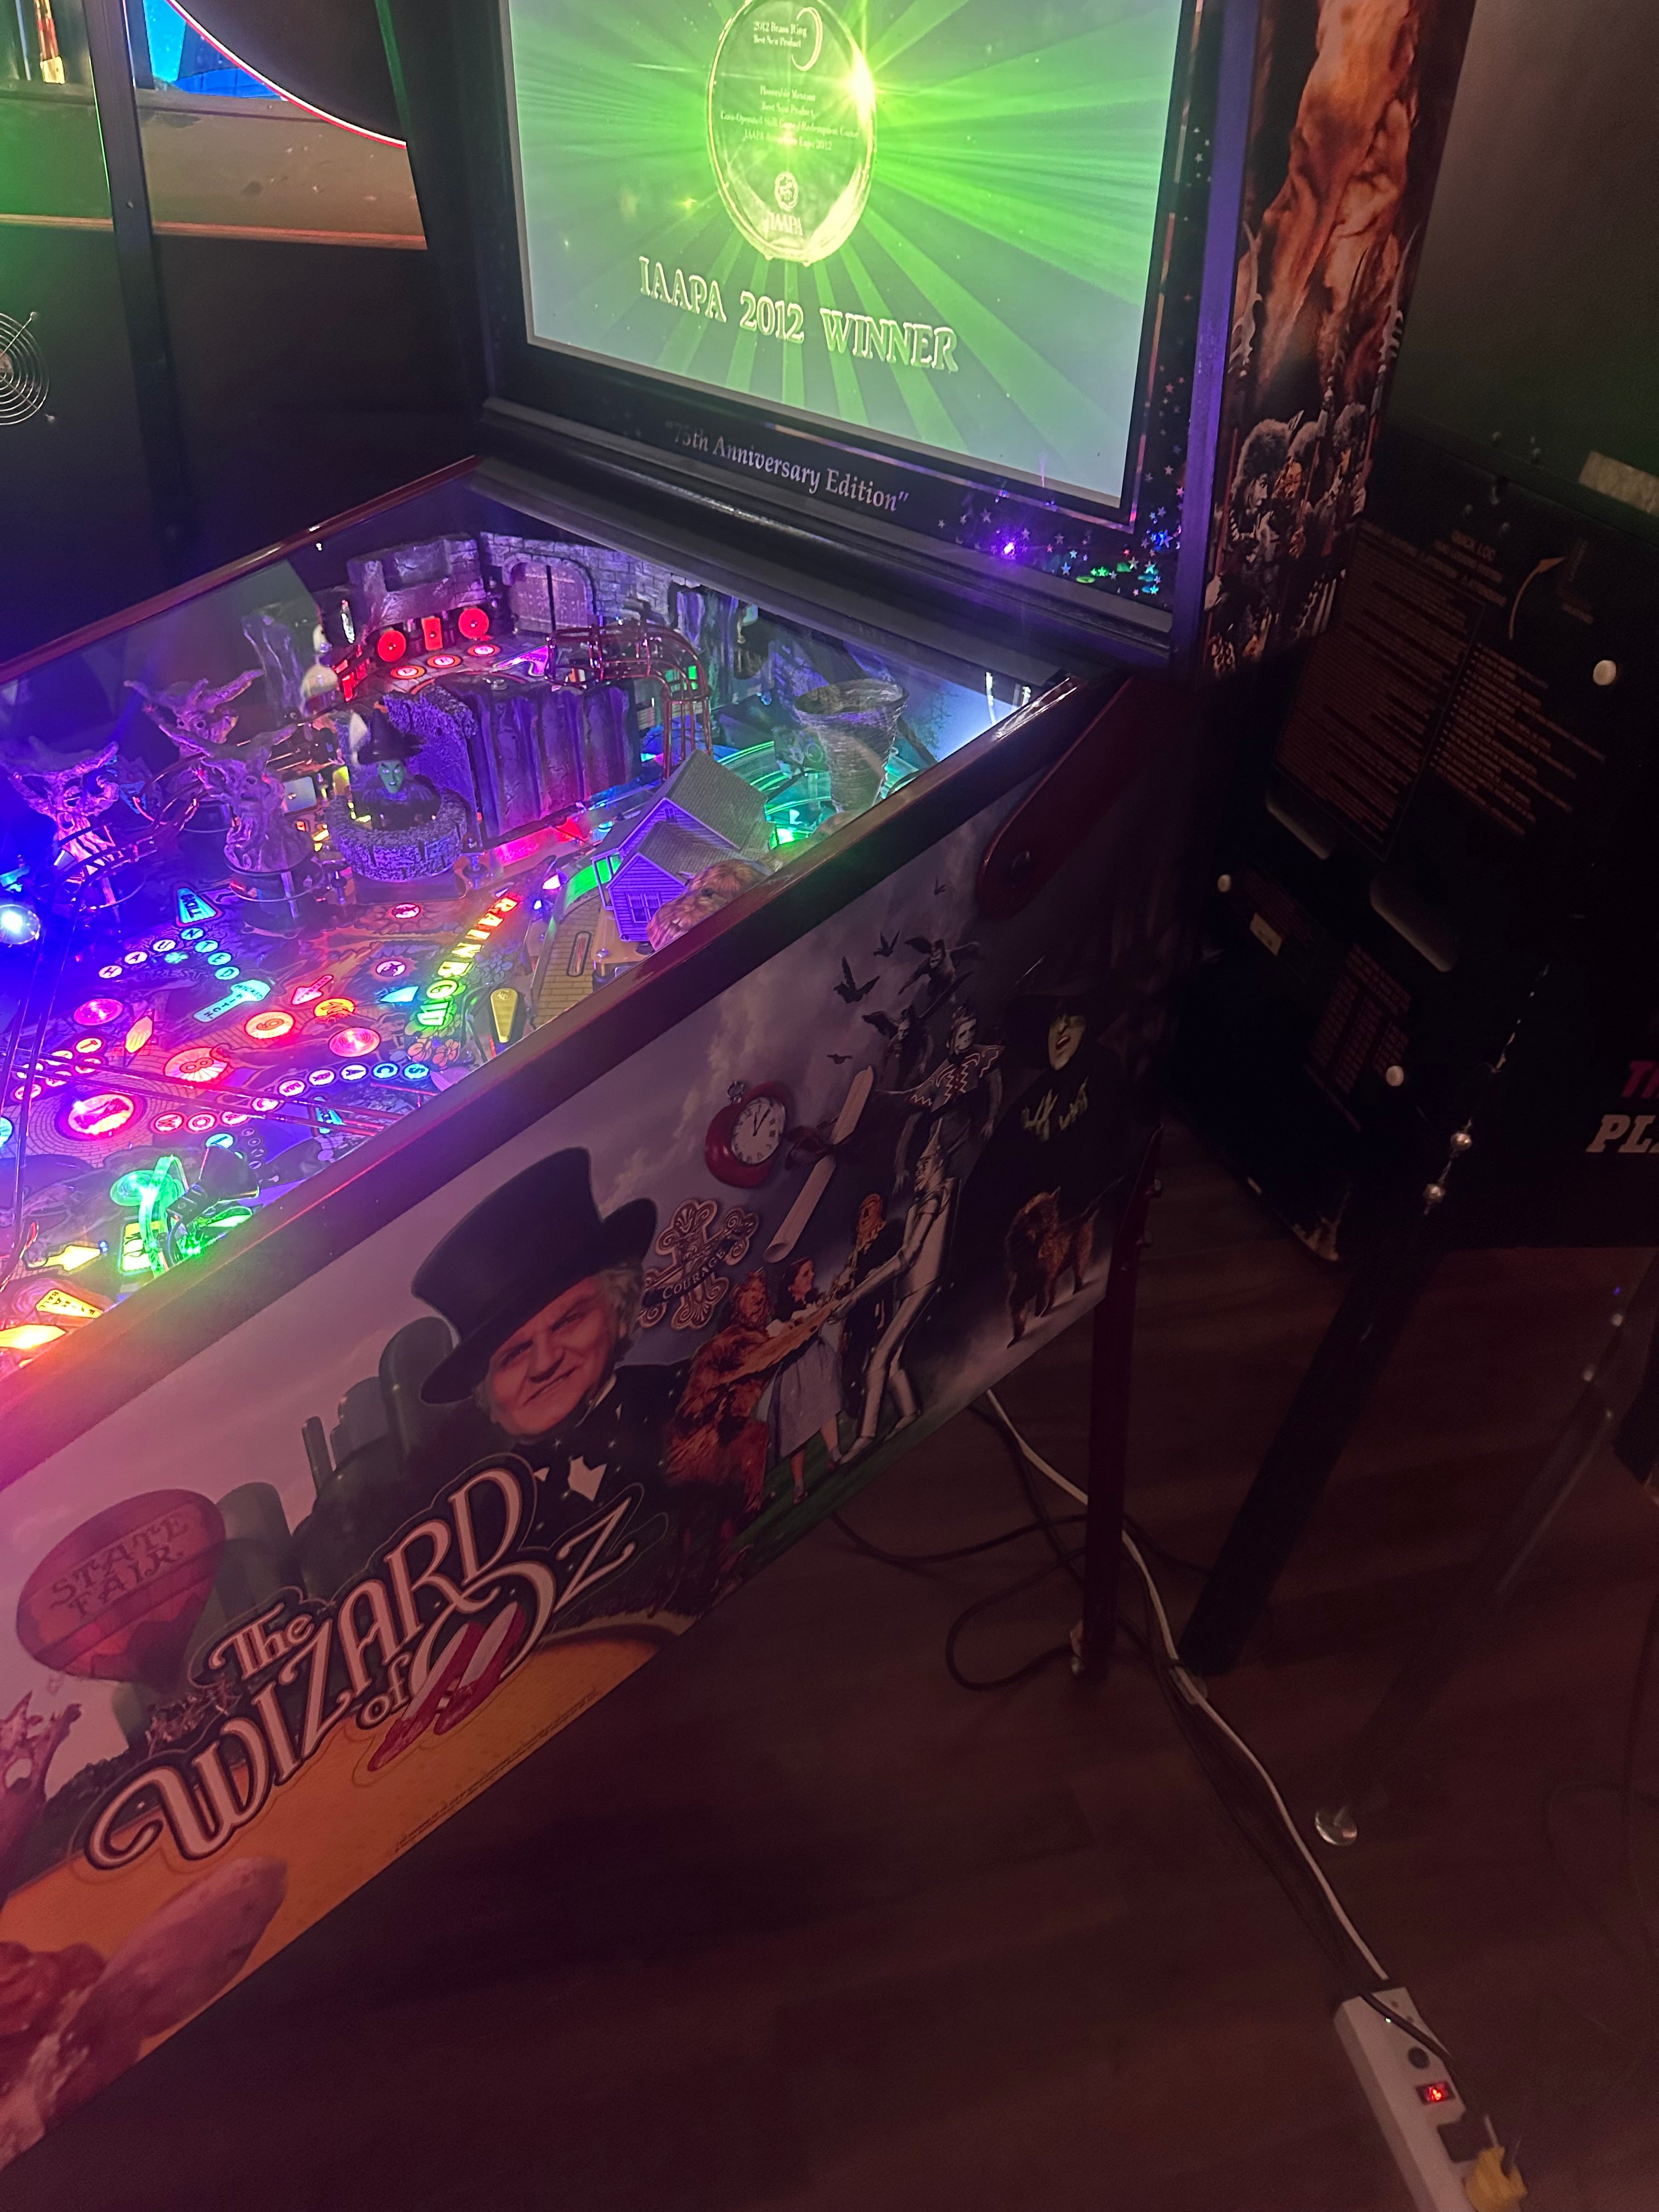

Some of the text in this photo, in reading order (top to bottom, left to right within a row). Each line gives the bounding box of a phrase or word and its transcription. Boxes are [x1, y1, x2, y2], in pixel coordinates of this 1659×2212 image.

[753, 21, 769, 32] 2012
[791, 24, 807, 38] Ring
[639, 256, 959, 373] IAAPA 2012 WINNER
[713, 435, 821, 494] Anniversary
[234, 984, 263, 1000] WICKED
[417, 896, 518, 1026] RAINBOW
[1584, 1114, 1659, 1153] PL
[662, 1249, 726, 1300] COURAGE
[50, 1517, 189, 1610] STATE
[87, 1468, 522, 1868] WIZARD
[208, 1602, 315, 1681] The
[359, 1650, 413, 1729] of
